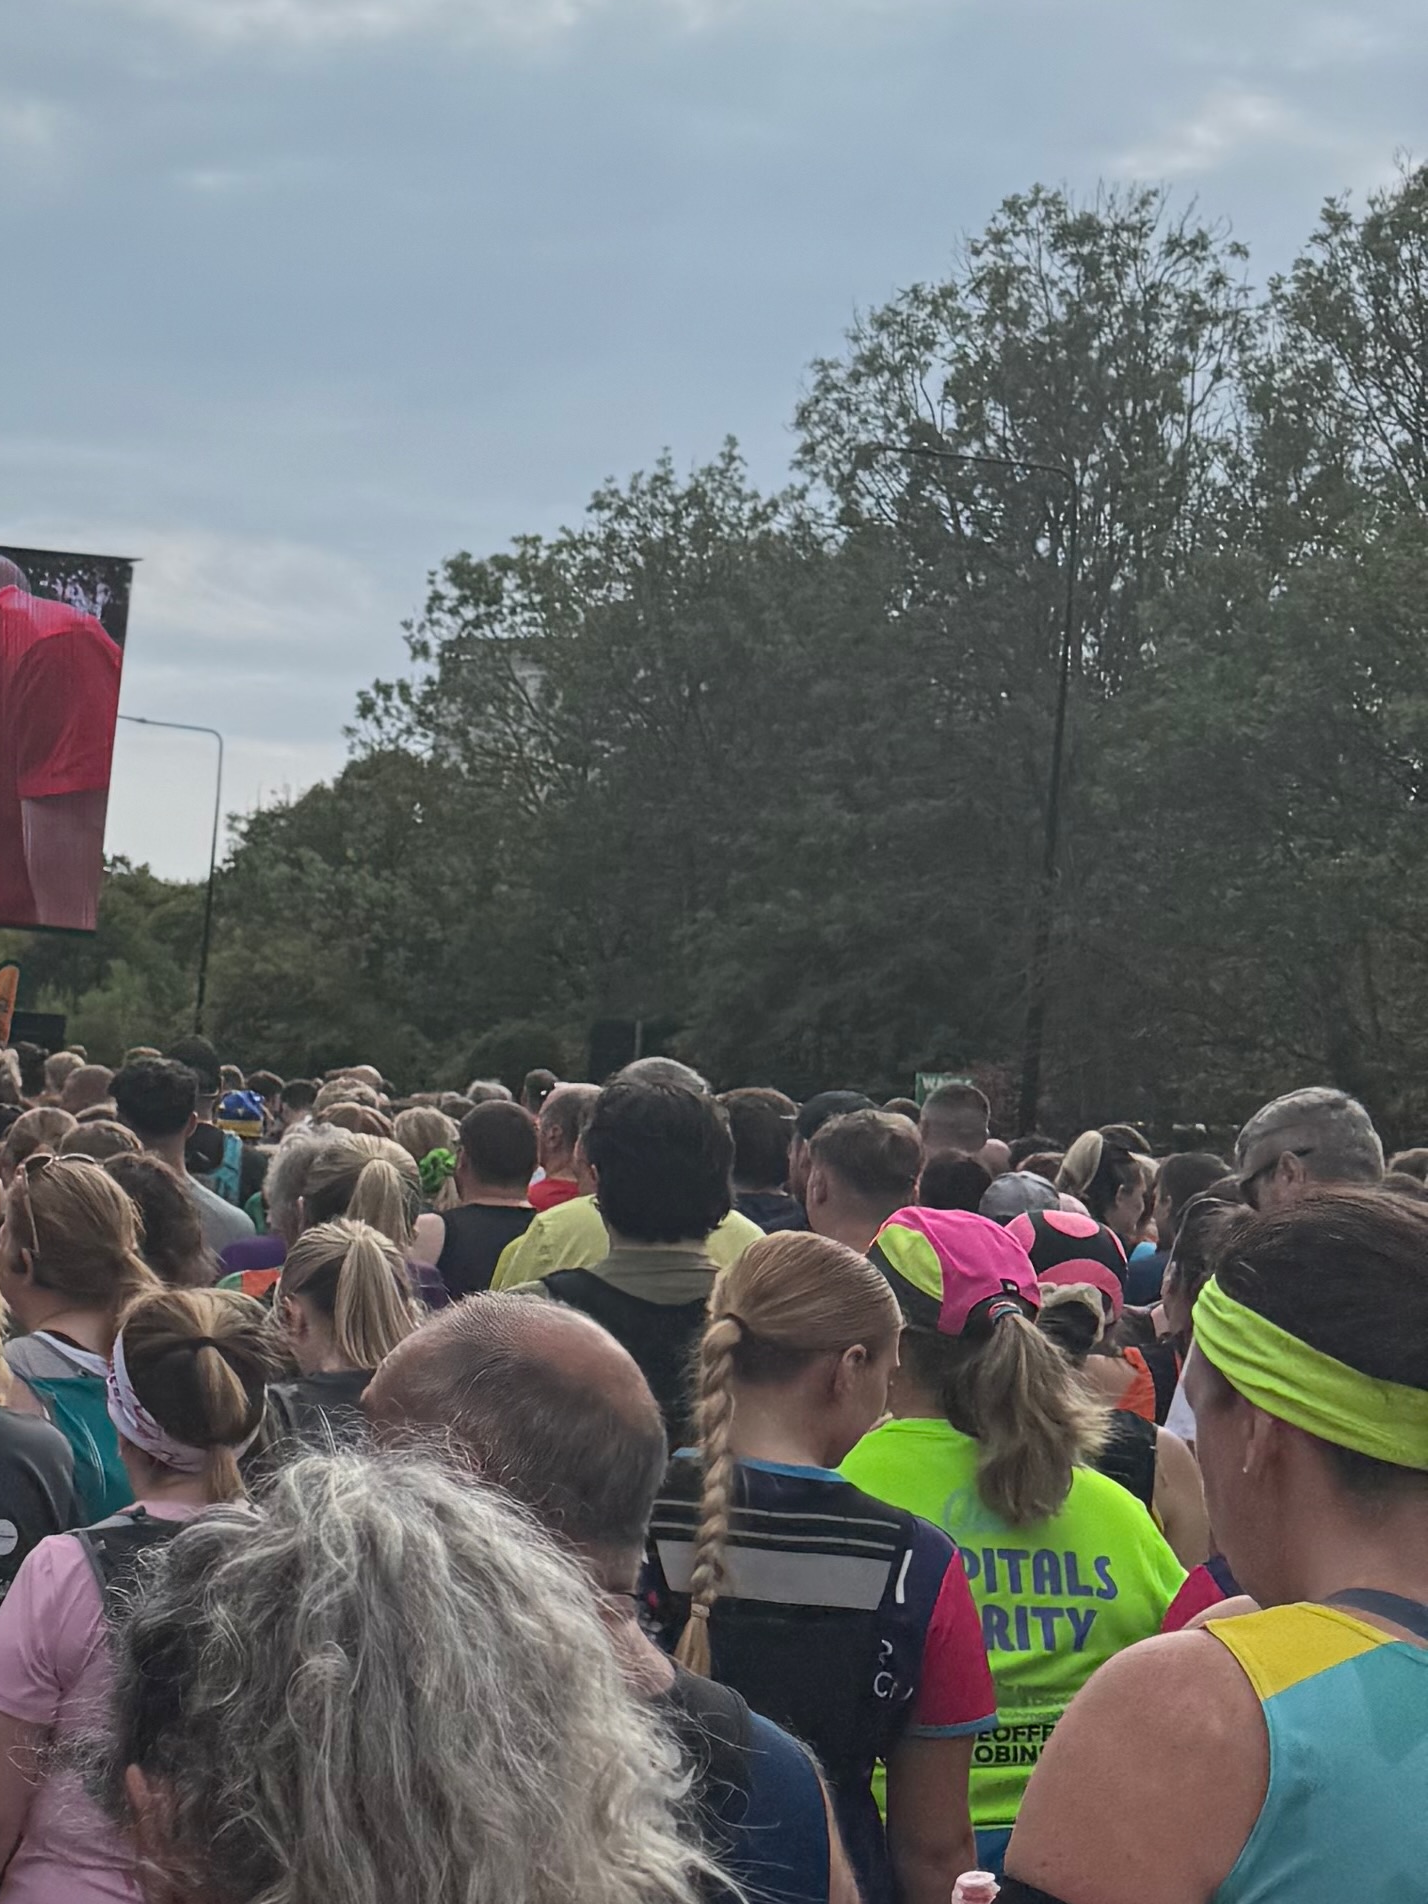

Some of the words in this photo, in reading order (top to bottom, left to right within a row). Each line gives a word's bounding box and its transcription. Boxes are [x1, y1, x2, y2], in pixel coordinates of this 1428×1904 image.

[959, 1547, 1119, 1601] PITALS
[980, 1603, 1098, 1653] RITY
[974, 1744, 1044, 1764] OBIN
